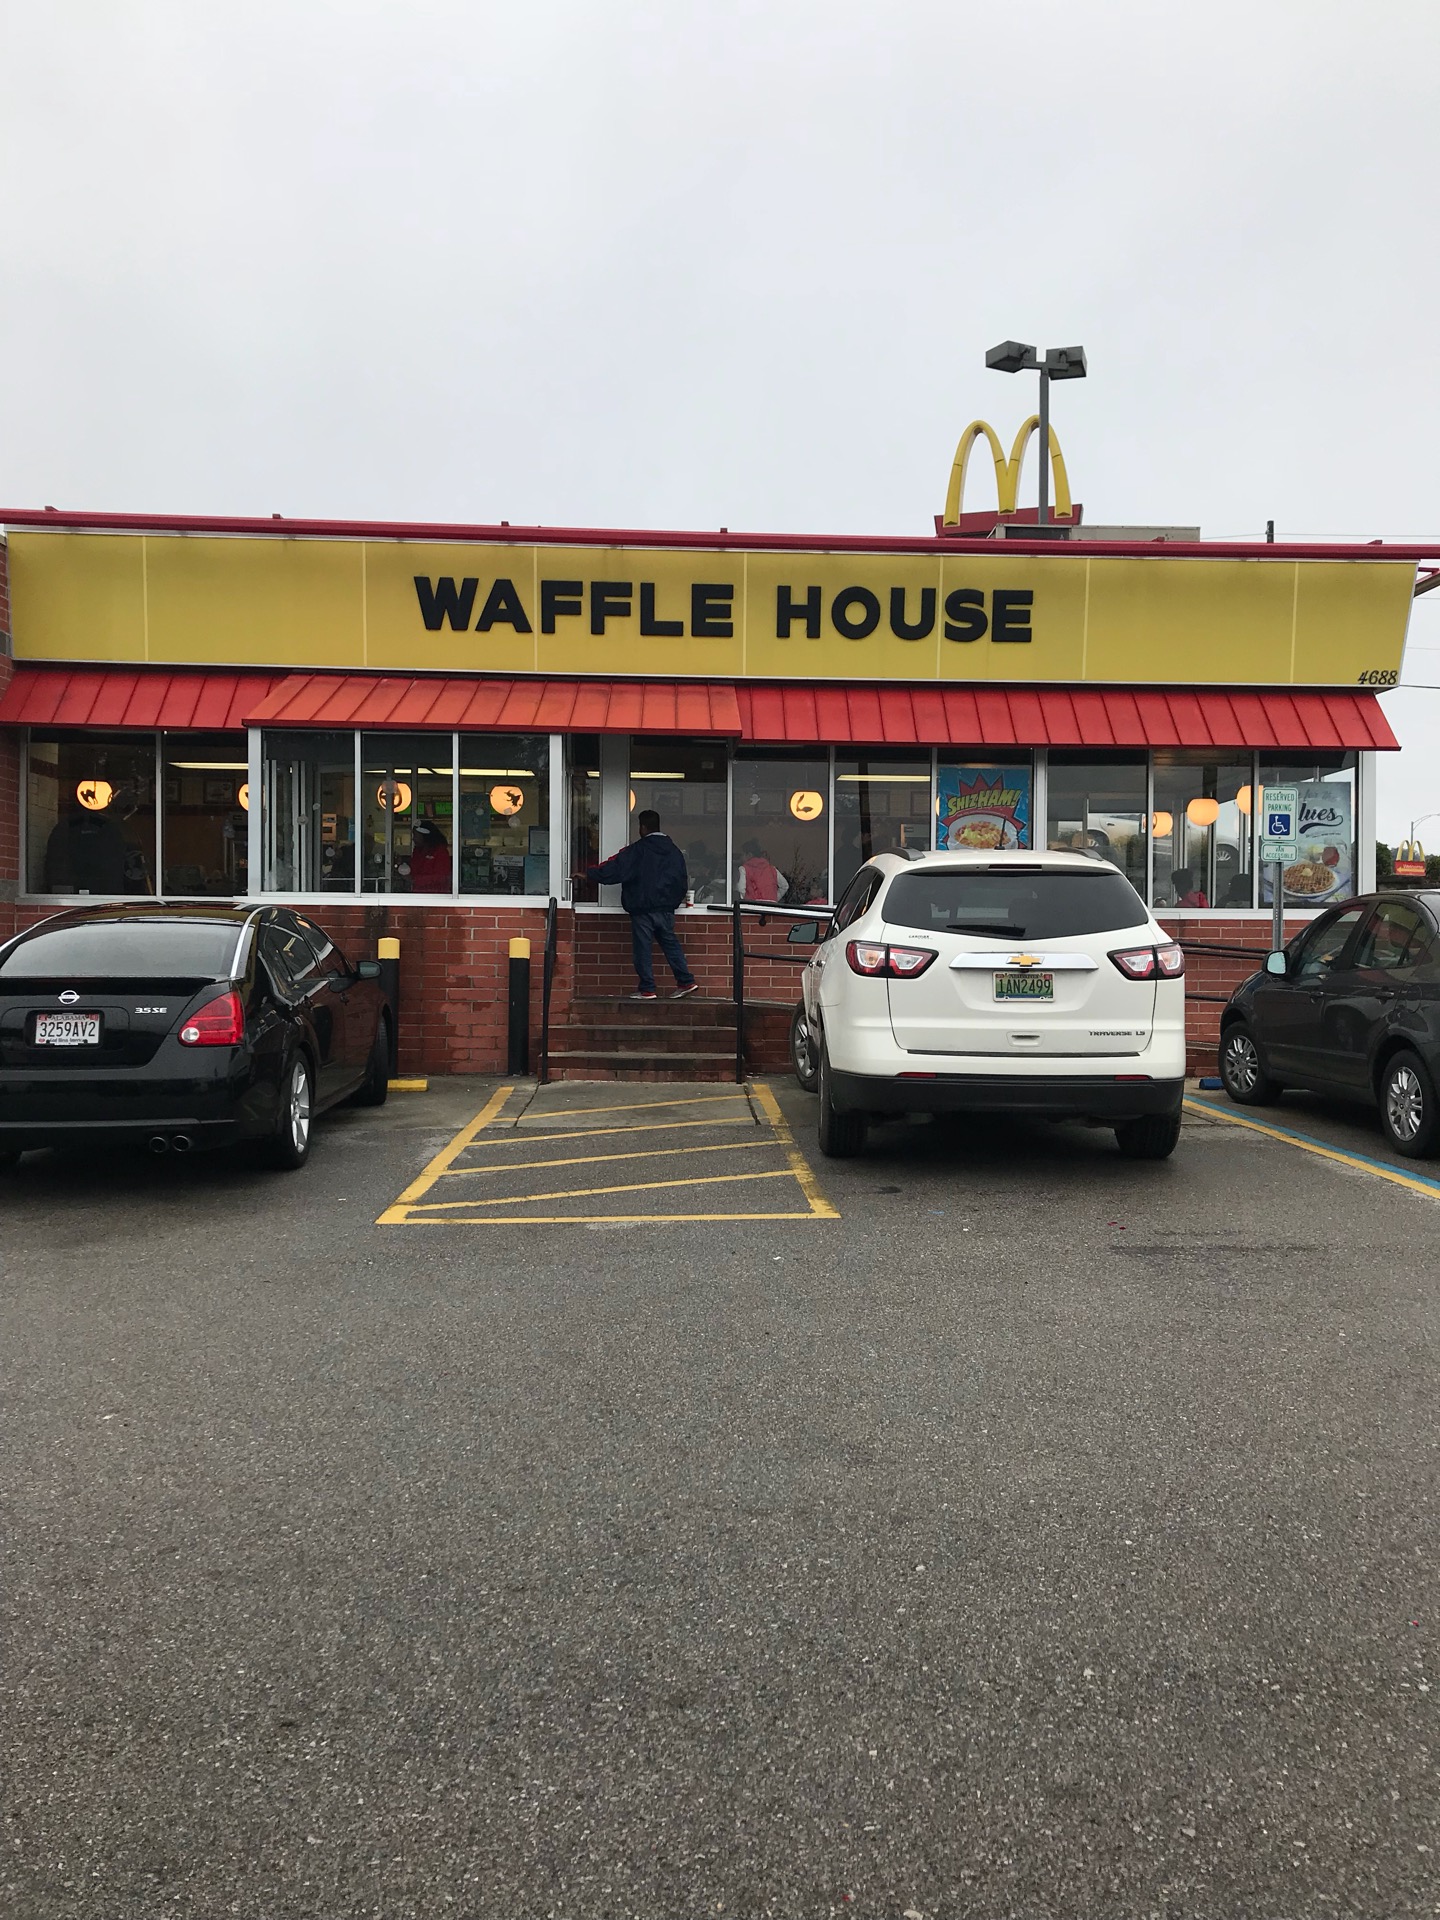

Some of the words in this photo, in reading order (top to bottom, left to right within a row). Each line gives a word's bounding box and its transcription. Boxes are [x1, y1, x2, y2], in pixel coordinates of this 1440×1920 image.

[414, 576, 734, 638] WAFFLE
[776, 585, 1034, 643] HOUSE
[1357, 670, 1398, 685] 4688
[947, 789, 1022, 816] SHIZHAM!
[1265, 792, 1295, 802] RESERVED
[1268, 803, 1292, 812] PARKING
[1298, 802, 1340, 823] lues
[999, 979, 1051, 994] 1AN2499
[39, 1021, 96, 1037] 3259AV2
